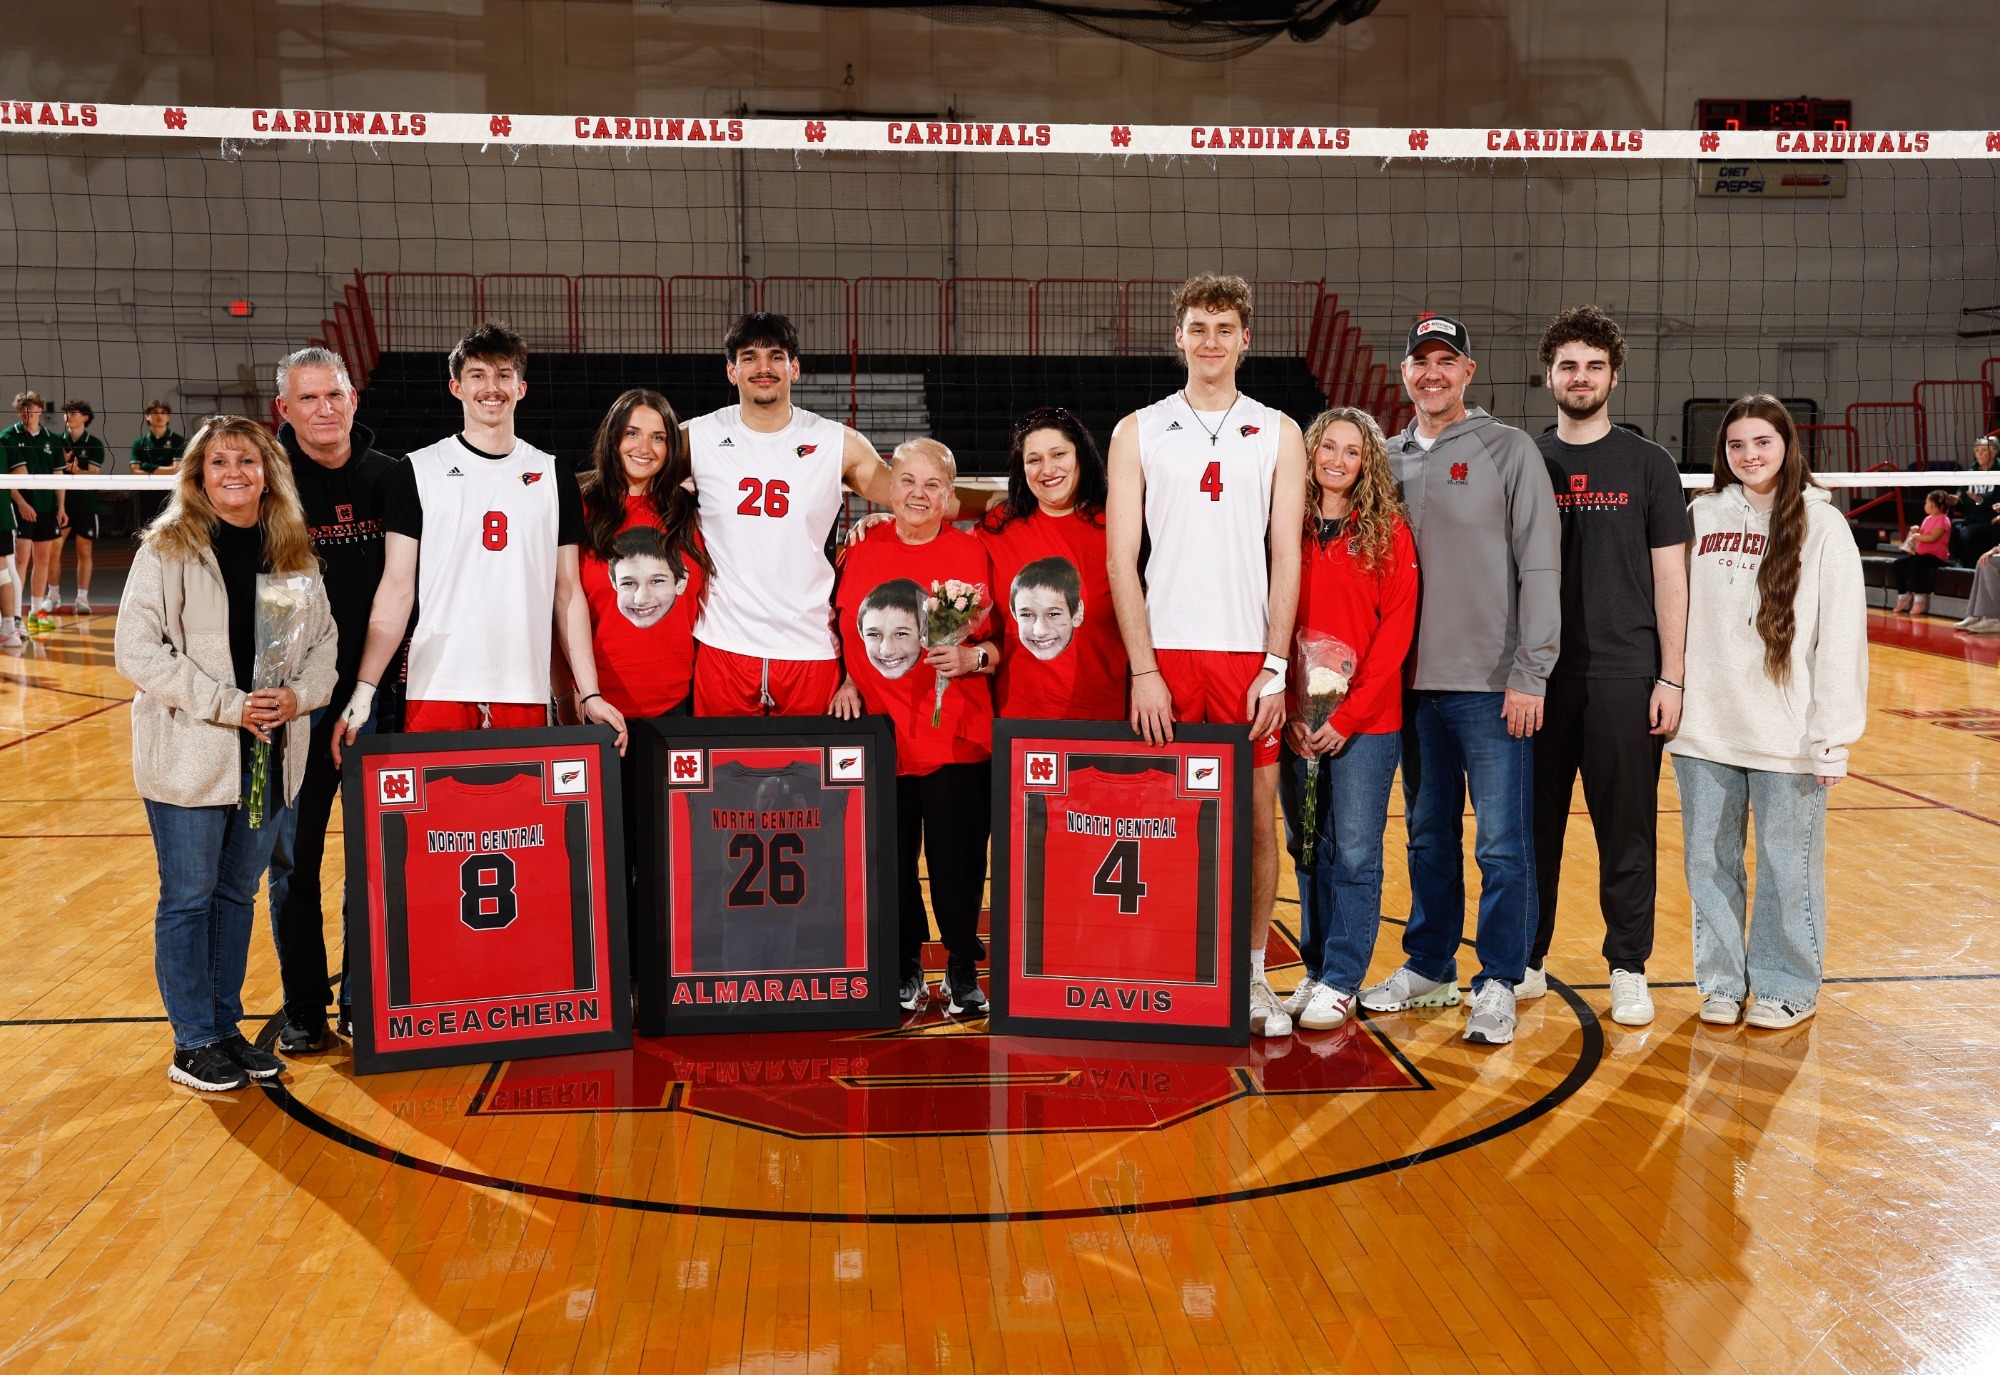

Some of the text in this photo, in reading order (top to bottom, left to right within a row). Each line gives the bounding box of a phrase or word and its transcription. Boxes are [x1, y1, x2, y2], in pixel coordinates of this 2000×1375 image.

[251, 109, 427, 137] CARDINALS
[574, 116, 744, 142] CARDINALS
[887, 122, 1051, 147] CARDINALS
[1190, 127, 1351, 150] CARDINALS
[1486, 129, 1644, 152] CARDINALS
[1776, 131, 1930, 153] CARDINALS
[1714, 180, 1766, 193] PEPSI
[1719, 167, 1750, 177] DIET
[737, 476, 790, 518] 26
[1200, 461, 1223, 501] 4
[482, 510, 508, 551] 8
[427, 823, 545, 853] NORTH CENTRAL
[711, 808, 821, 830] NORTH CENTRAL
[1066, 810, 1177, 839] NORTH CENTRAL
[727, 831, 806, 908] 26
[1092, 838, 1147, 915] 4
[459, 851, 518, 931] 8
[671, 977, 869, 1005] ALMARALES
[1065, 985, 1173, 1013] DAVIS
[388, 998, 599, 1040] McEACHERN
